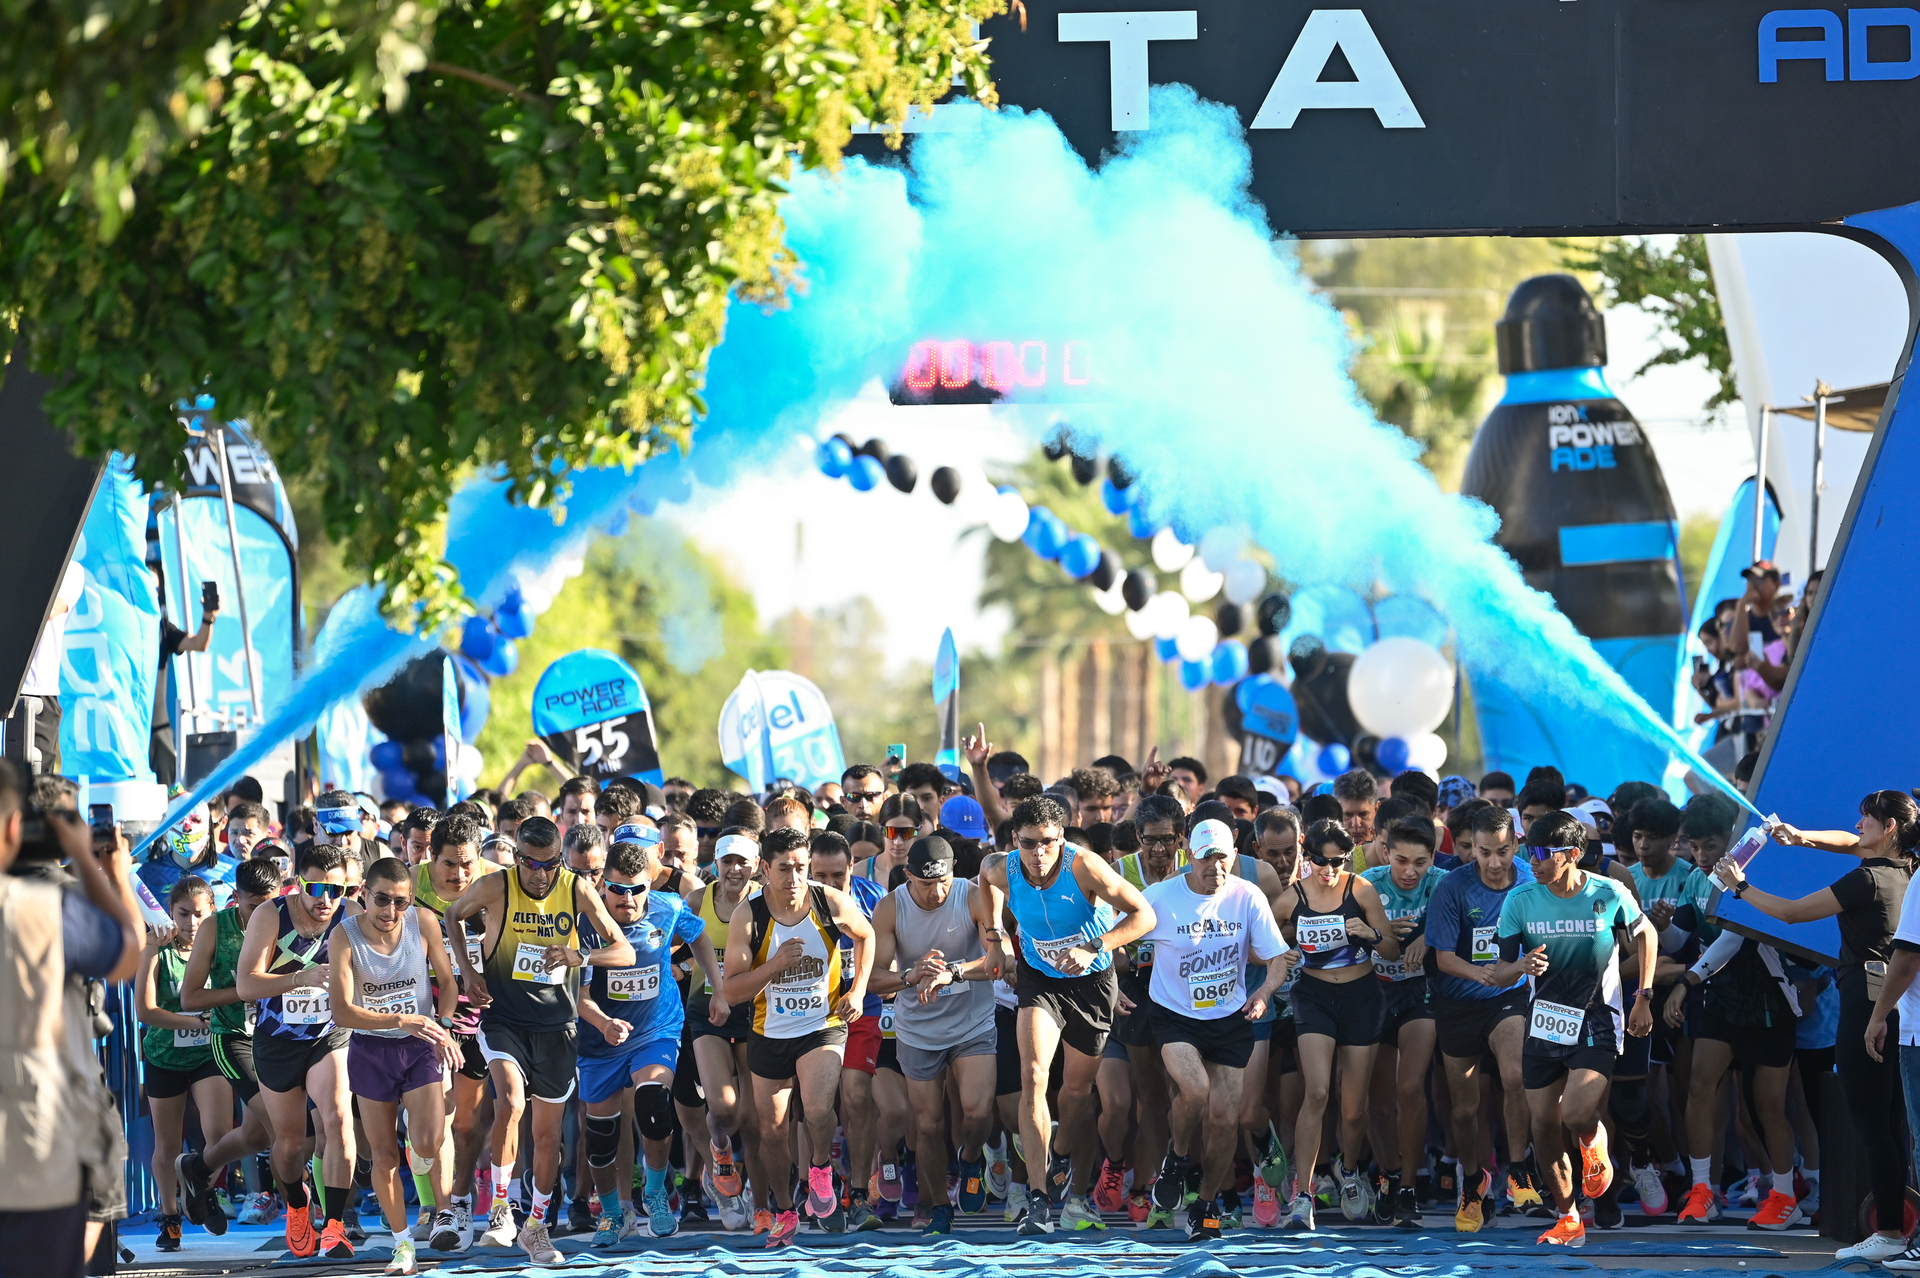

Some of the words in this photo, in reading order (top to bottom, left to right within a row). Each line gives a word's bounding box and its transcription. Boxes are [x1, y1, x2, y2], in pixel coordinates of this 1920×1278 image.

[1551, 444, 1617, 472] ADE
[545, 679, 625, 710] POWER
[581, 694, 628, 717] ADE
[575, 715, 629, 767] 55
[597, 758, 622, 774] MIN
[1176, 918, 1243, 935] NICANOR
[1526, 918, 1606, 935] HALCONES
[1034, 935, 1081, 948] POWERADE
[1298, 928, 1344, 944] 1252
[520, 944, 546, 954] POWE
[1179, 941, 1239, 979] BONITA
[532, 973, 549, 983] ciel
[610, 966, 657, 977] POWERADE
[1190, 967, 1237, 982] POWERADE
[363, 977, 417, 994] ENTRENA
[610, 976, 658, 992] 0419
[1193, 978, 1237, 1001] 0867
[364, 991, 413, 1004] POWERADE
[774, 996, 823, 1011] 1092
[285, 998, 331, 1014] 0711
[790, 1009, 806, 1017] ciel
[1536, 1001, 1582, 1018] POWERADE
[302, 1014, 318, 1024] ciel
[1534, 1013, 1579, 1037] 0903
[1547, 1032, 1561, 1042] ciel
